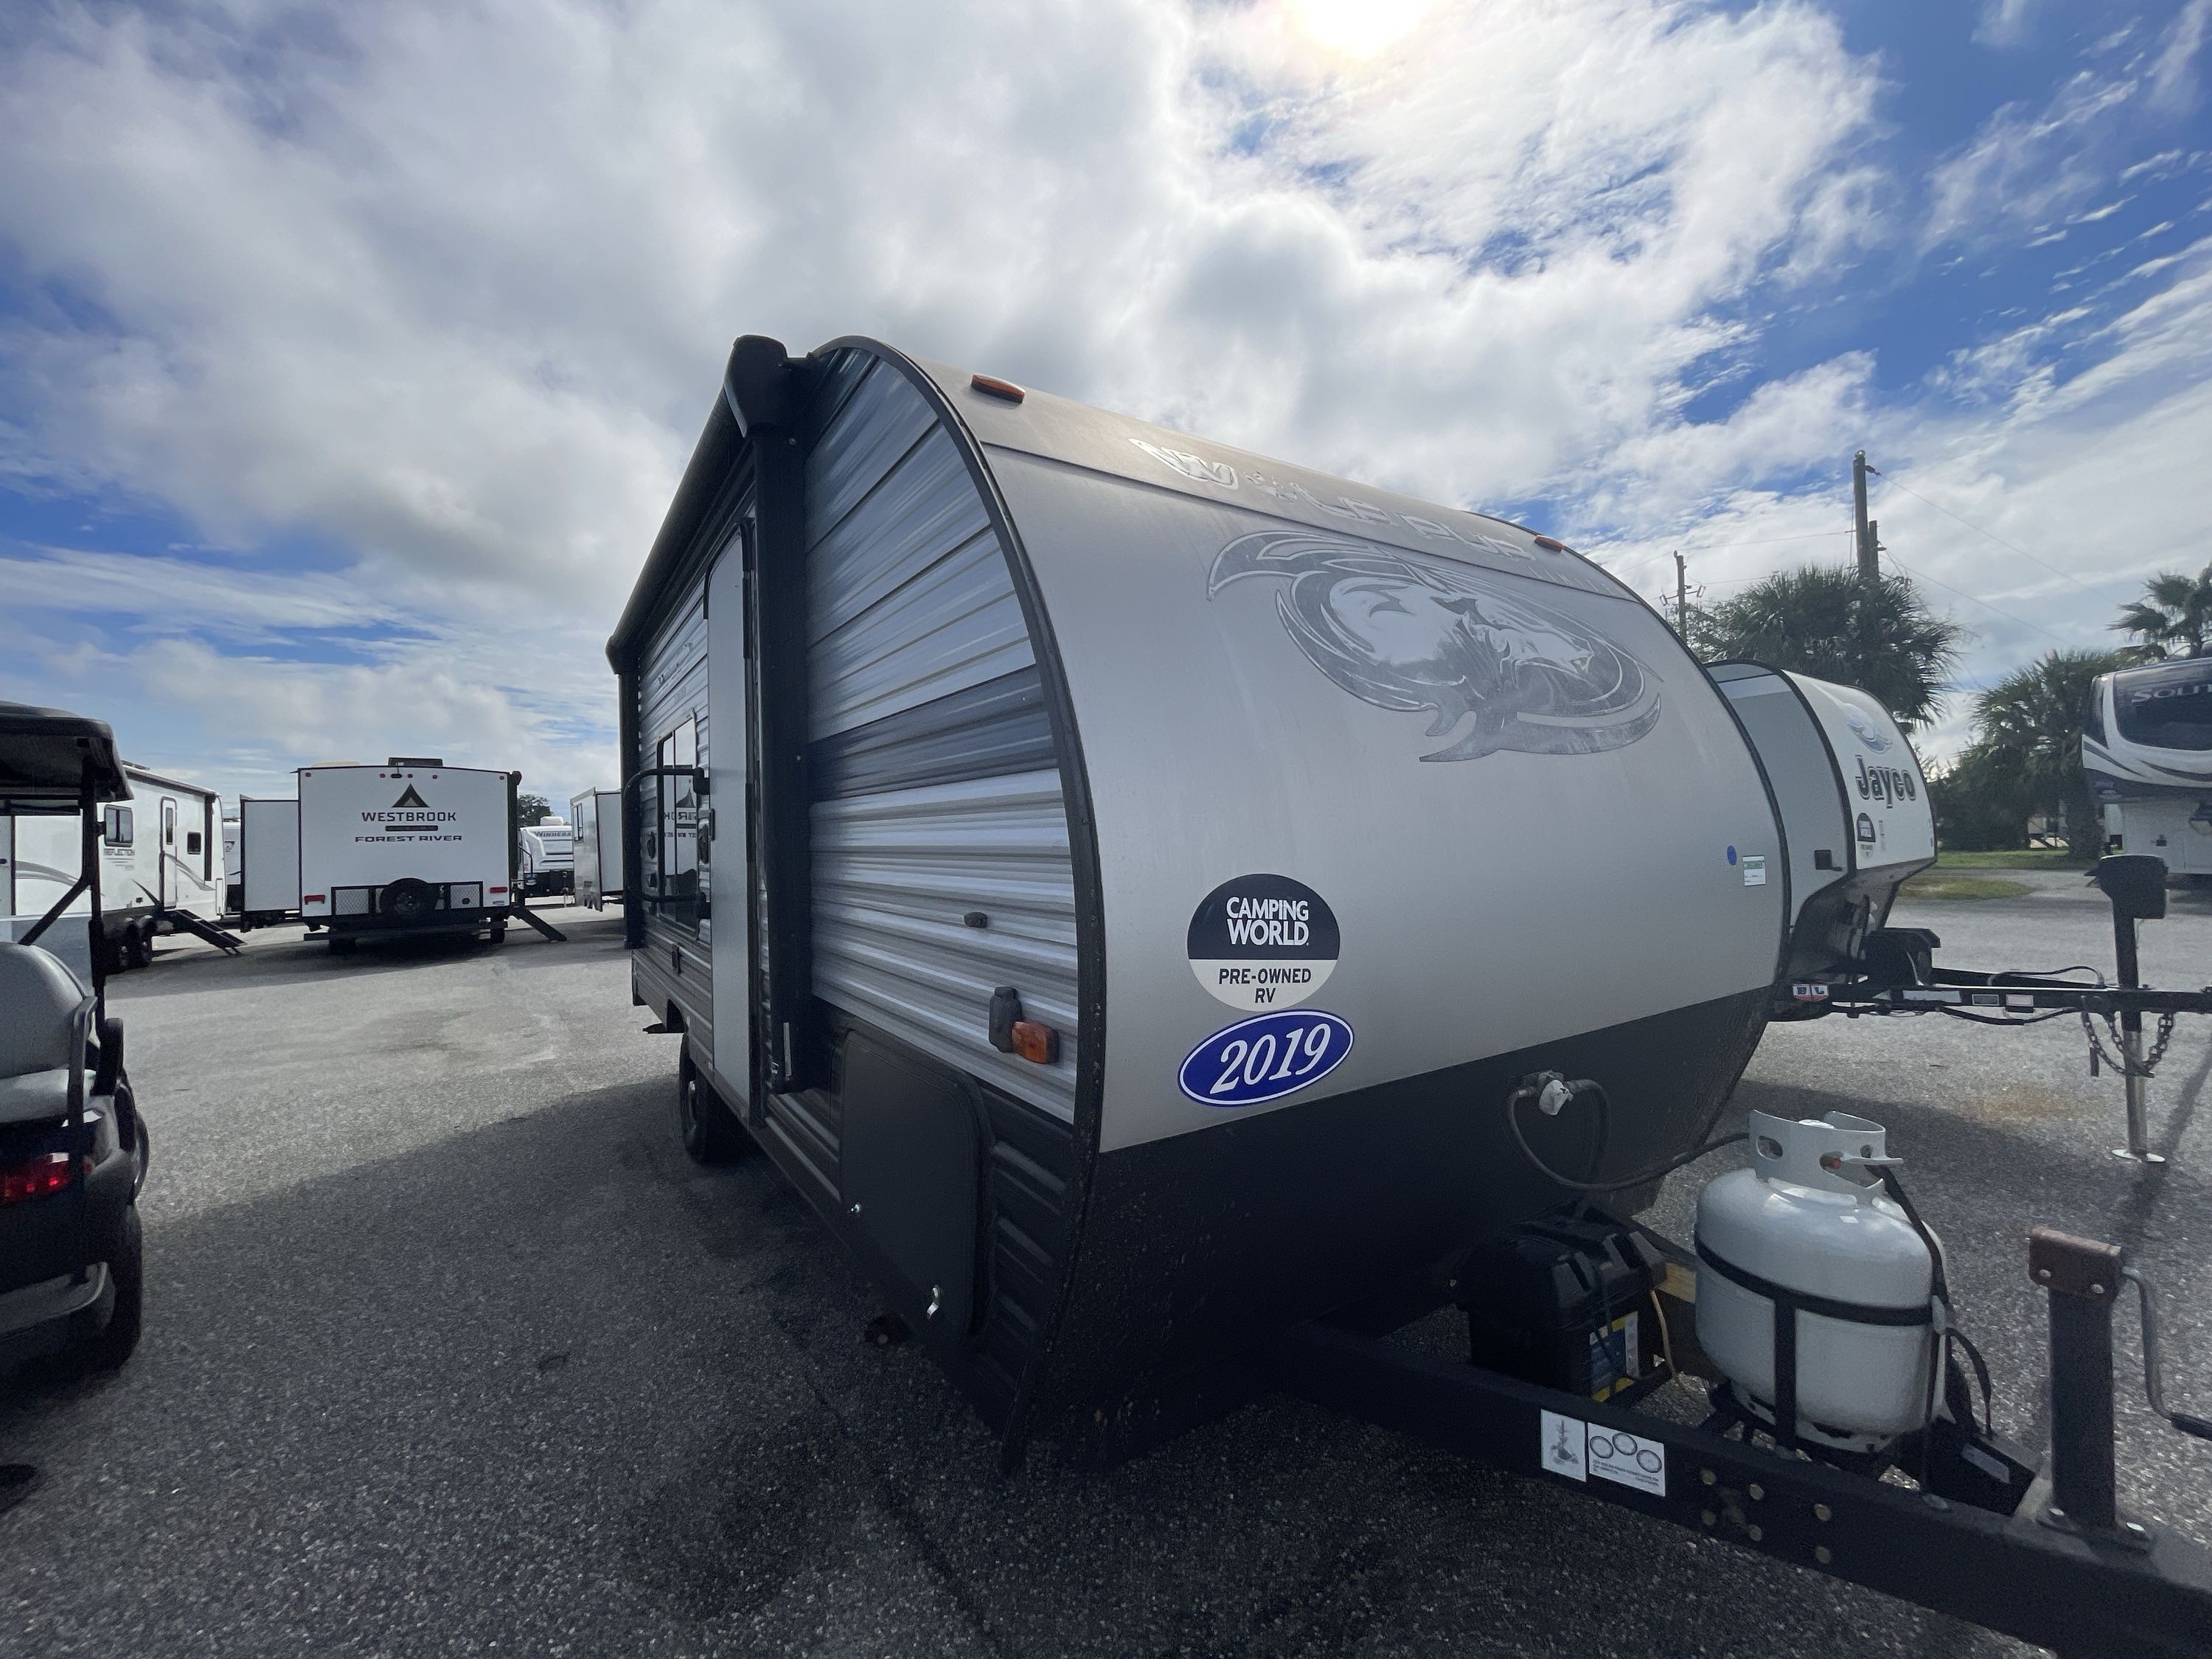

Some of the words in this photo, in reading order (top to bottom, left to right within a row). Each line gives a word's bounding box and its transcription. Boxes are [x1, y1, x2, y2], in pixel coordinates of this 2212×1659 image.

[1854, 754, 1916, 809] Jayco
[361, 812, 456, 822] WESTBROOK
[1226, 897, 1309, 921] CAMPING
[1227, 919, 1310, 946] WORLD
[1219, 968, 1312, 984] PRE-OWNED
[1255, 988, 1276, 1004] RV
[1210, 1023, 1331, 1094] 2019
